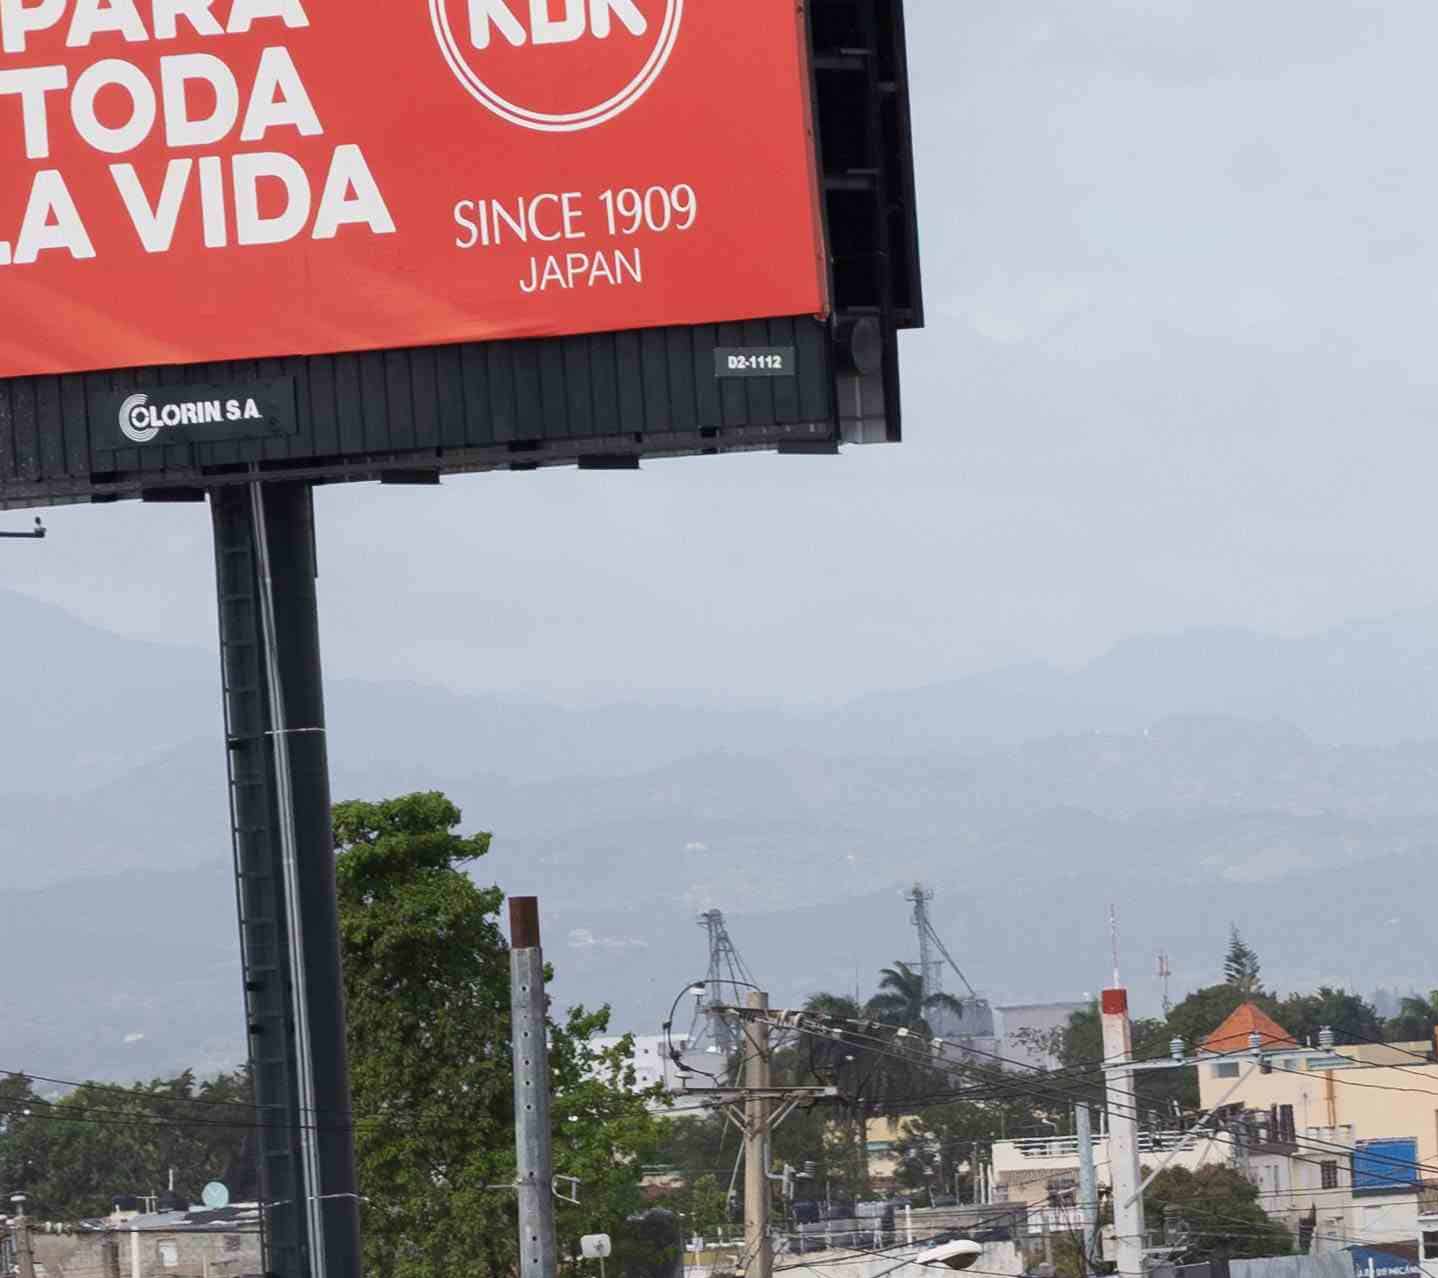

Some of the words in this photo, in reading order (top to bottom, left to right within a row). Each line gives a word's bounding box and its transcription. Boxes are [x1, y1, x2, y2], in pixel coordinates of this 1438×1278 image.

[0, 46, 324, 160] TODA
[109, 143, 397, 253] VIDA
[454, 191, 584, 250] SINCE
[599, 183, 698, 235] 1909
[519, 248, 642, 293] JAPAN
[728, 354, 782, 370] D2-1112
